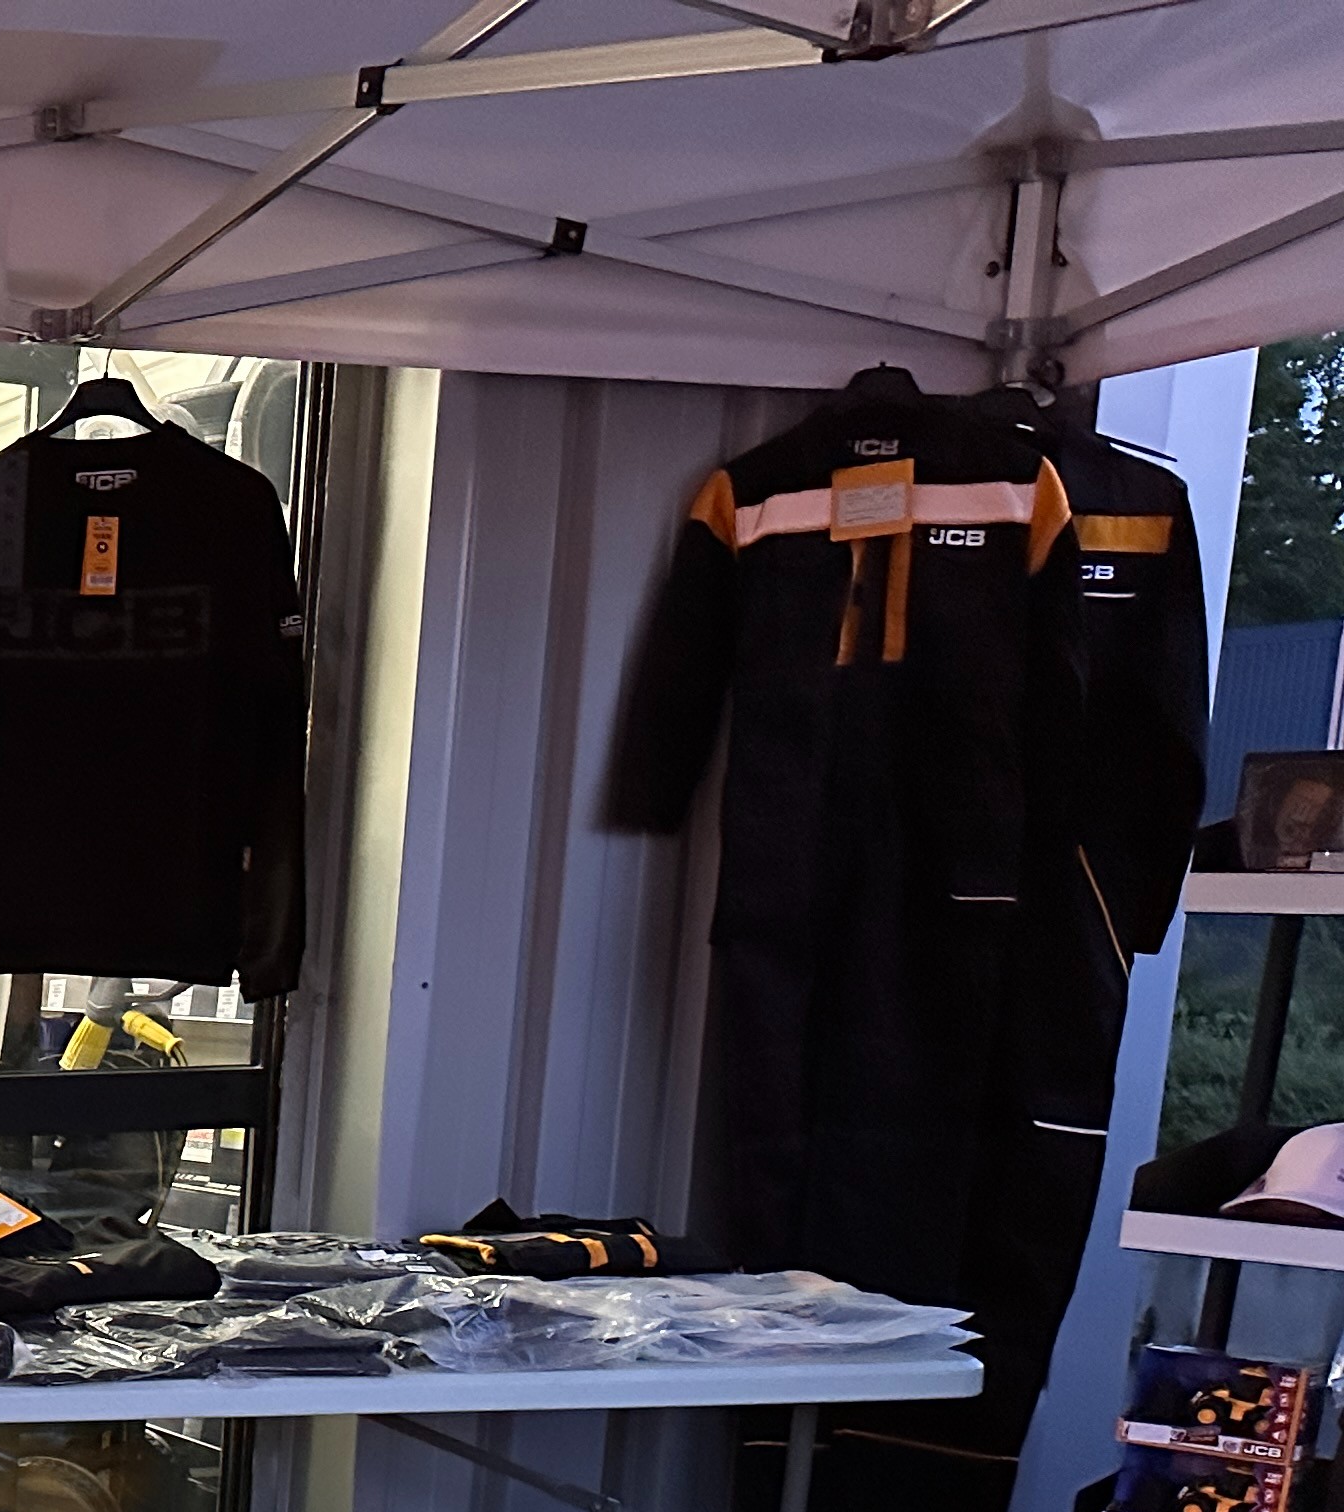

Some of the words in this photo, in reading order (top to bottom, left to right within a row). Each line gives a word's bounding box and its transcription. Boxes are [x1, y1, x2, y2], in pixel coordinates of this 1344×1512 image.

[929, 529, 986, 546] JCB
[1081, 565, 1114, 580] CB
[280, 615, 302, 627] JC
[1243, 1444, 1282, 1458] JCB
